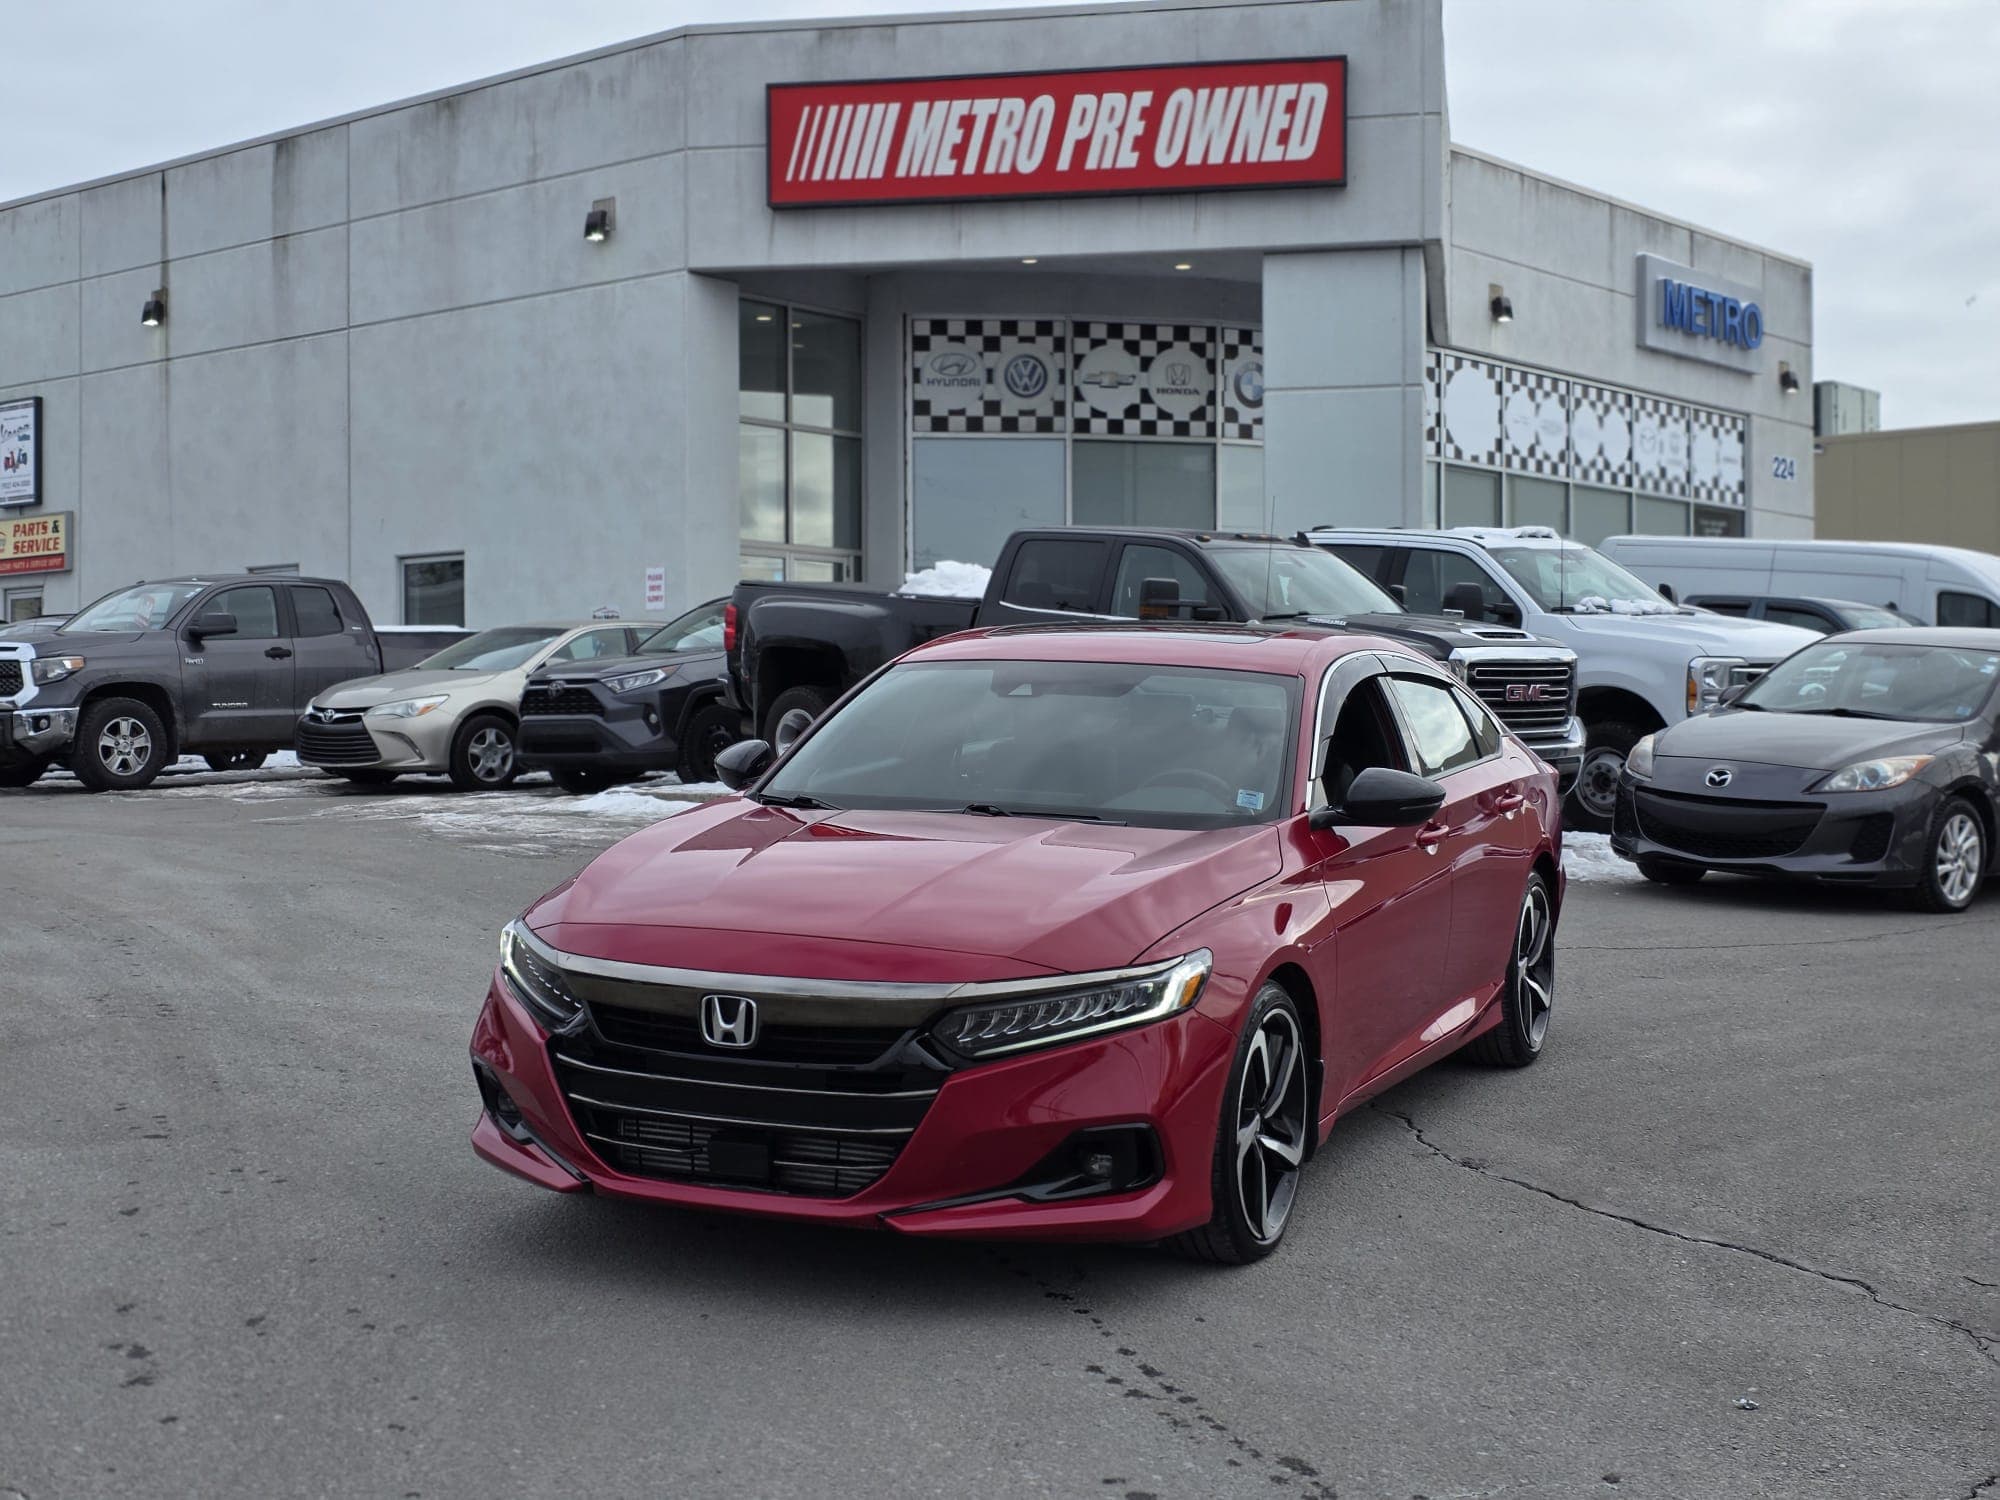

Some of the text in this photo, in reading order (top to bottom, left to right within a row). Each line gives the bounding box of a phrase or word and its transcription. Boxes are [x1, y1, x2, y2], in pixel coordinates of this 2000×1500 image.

[895, 82, 1328, 178] METRO PRE OWNED
[1660, 279, 1764, 350] METRO
[927, 378, 980, 387] HYUNDAI
[1156, 387, 1200, 396] HONDA
[1771, 456, 1795, 480] 224
[13, 520, 60, 537] PARTS &
[13, 537, 61, 555] SERVICE
[1506, 684, 1551, 701] GMC
